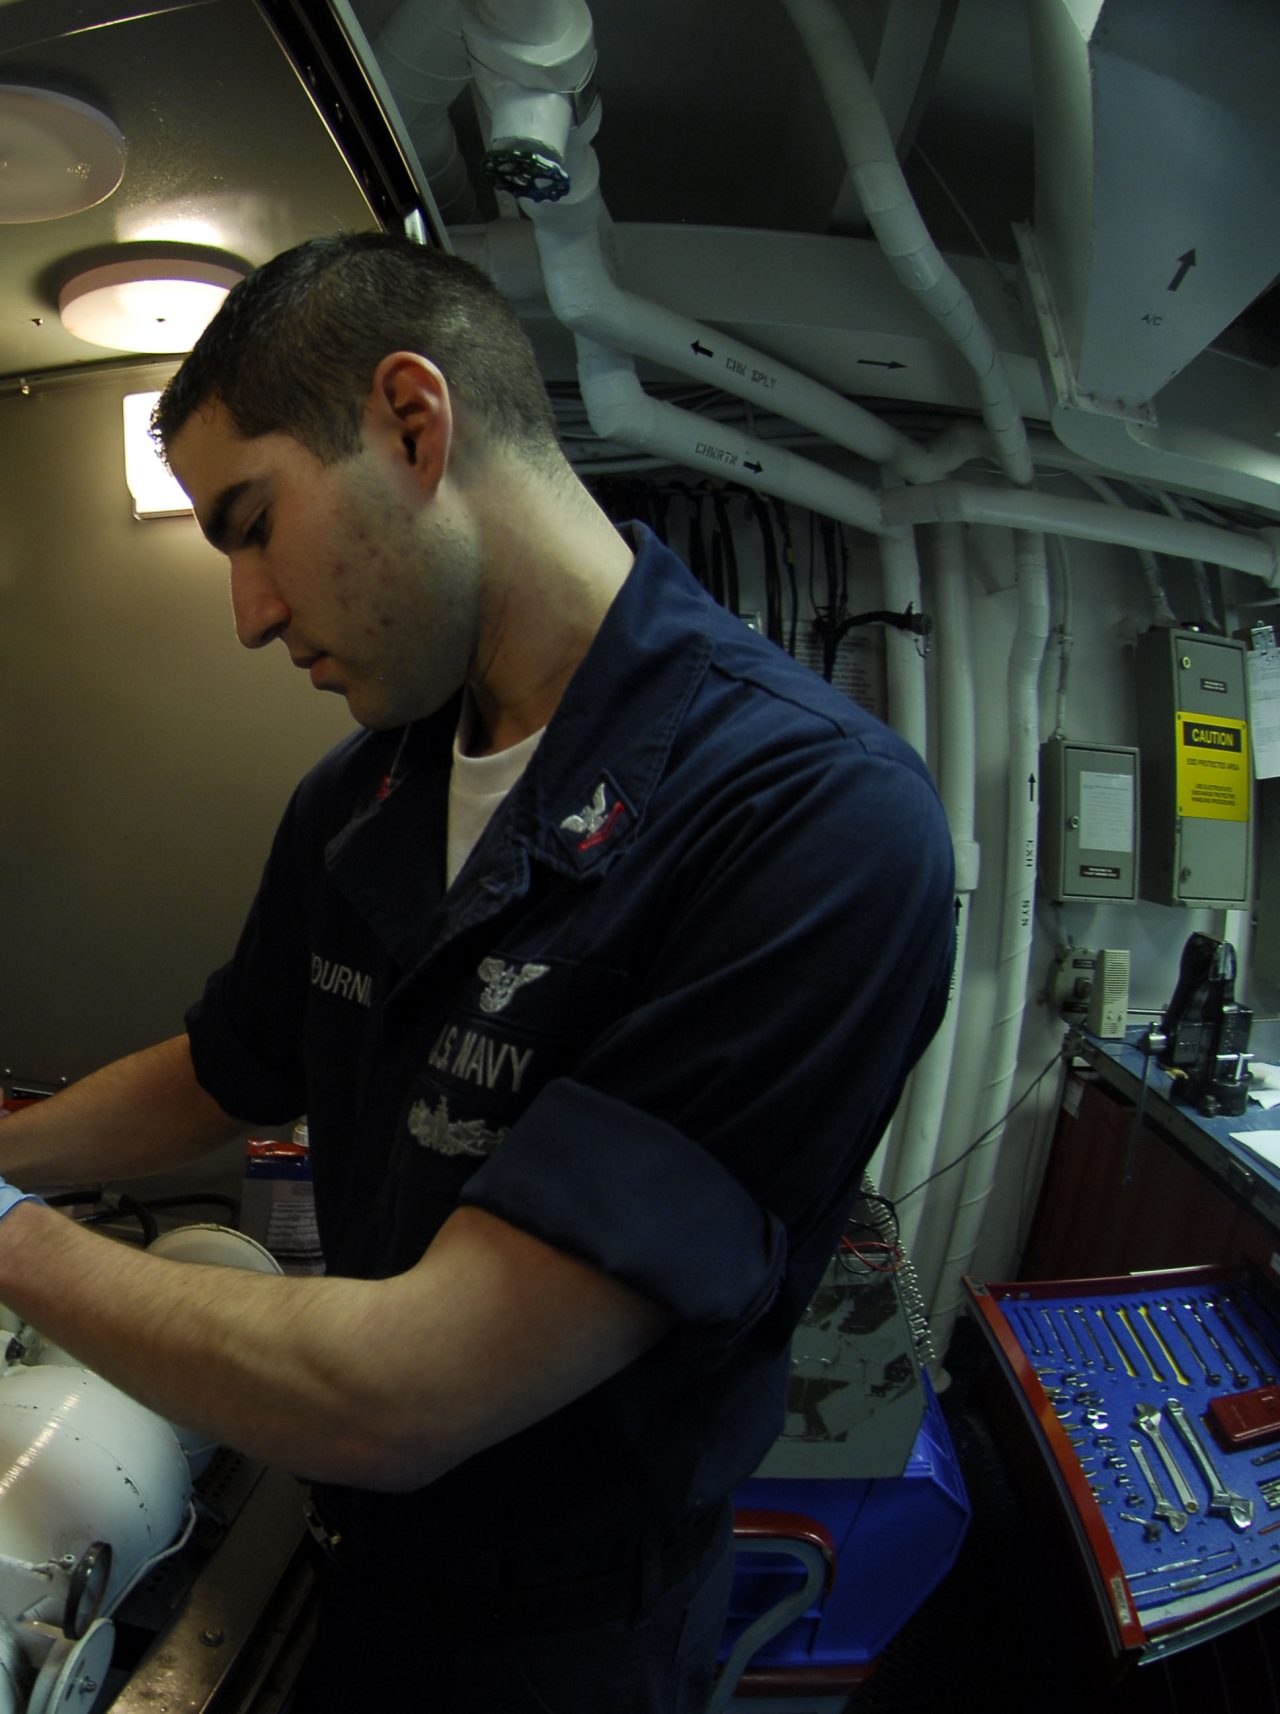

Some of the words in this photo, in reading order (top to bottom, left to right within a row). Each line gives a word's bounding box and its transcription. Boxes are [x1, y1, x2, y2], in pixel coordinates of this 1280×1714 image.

[1141, 314, 1162, 326] A/C
[1191, 728, 1234, 747] CAUTION
[451, 1029, 534, 1093] NAVY
